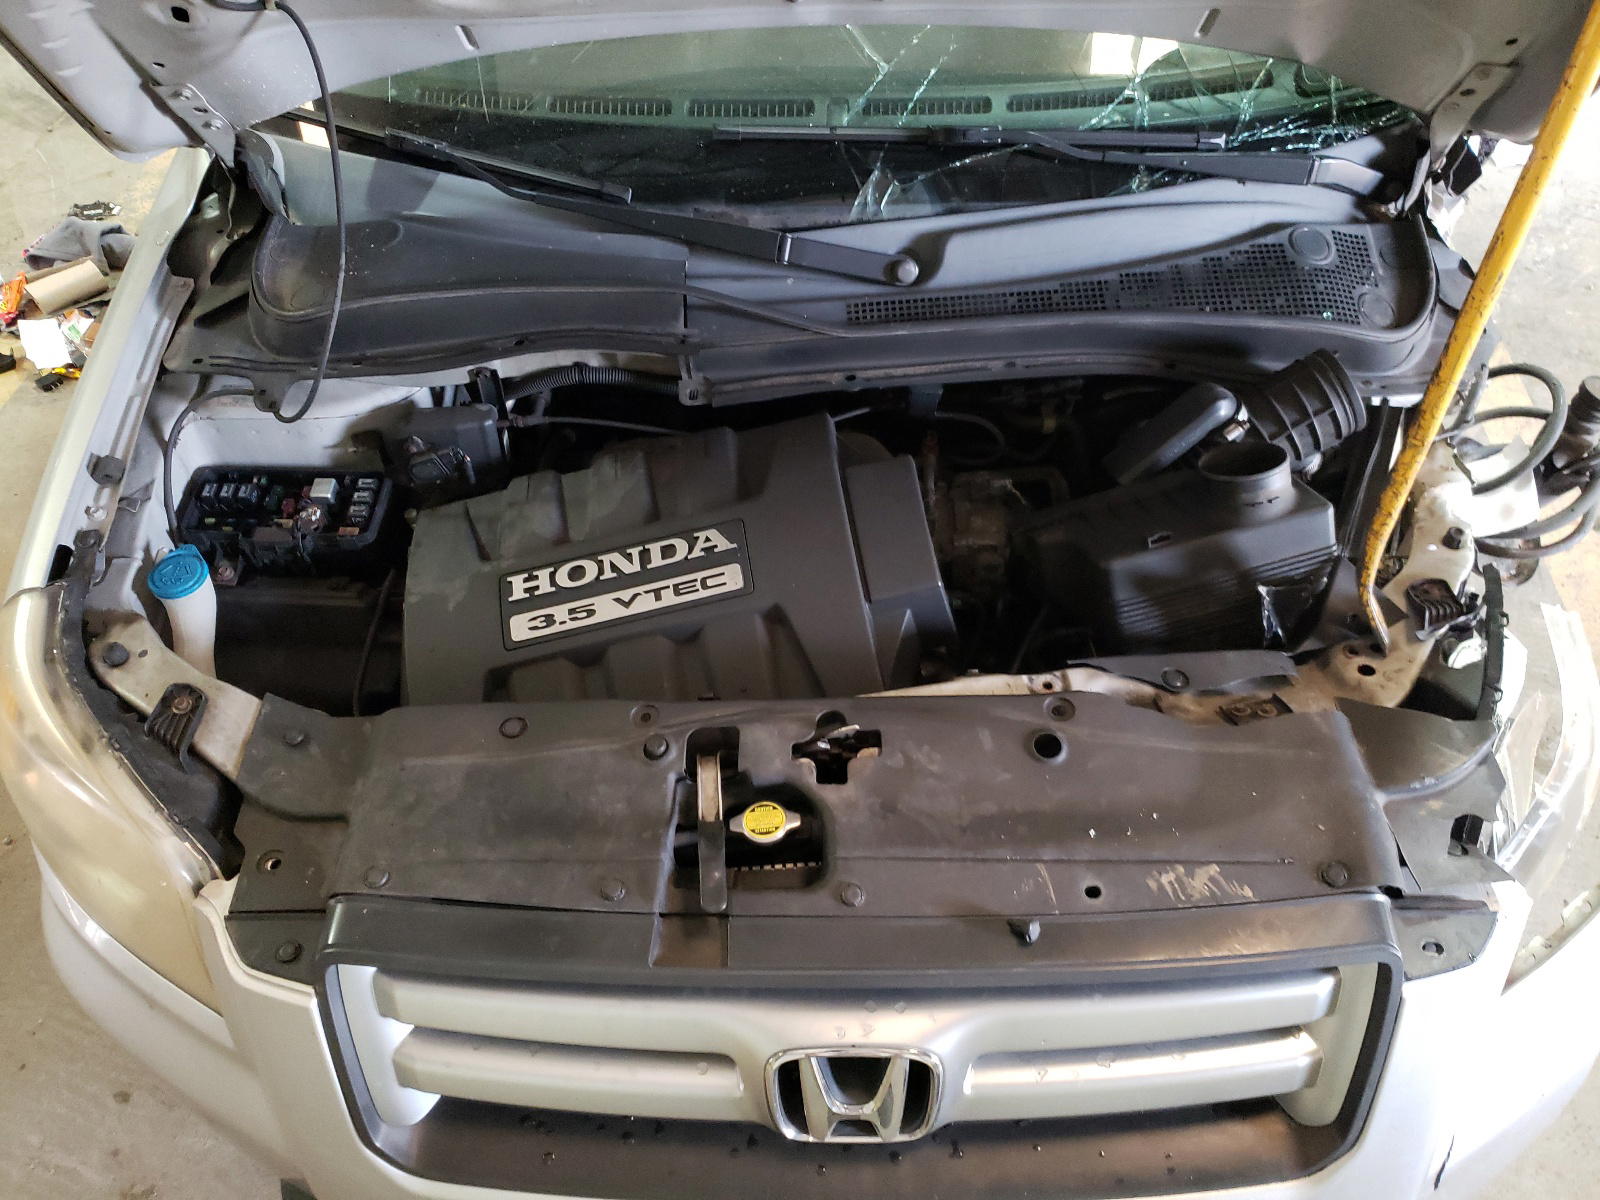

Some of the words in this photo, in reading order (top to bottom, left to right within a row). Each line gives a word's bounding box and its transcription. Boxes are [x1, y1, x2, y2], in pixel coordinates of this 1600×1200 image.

[507, 528, 737, 602] HONDA
[527, 603, 597, 631] 3.5
[612, 571, 728, 610] VTEC
